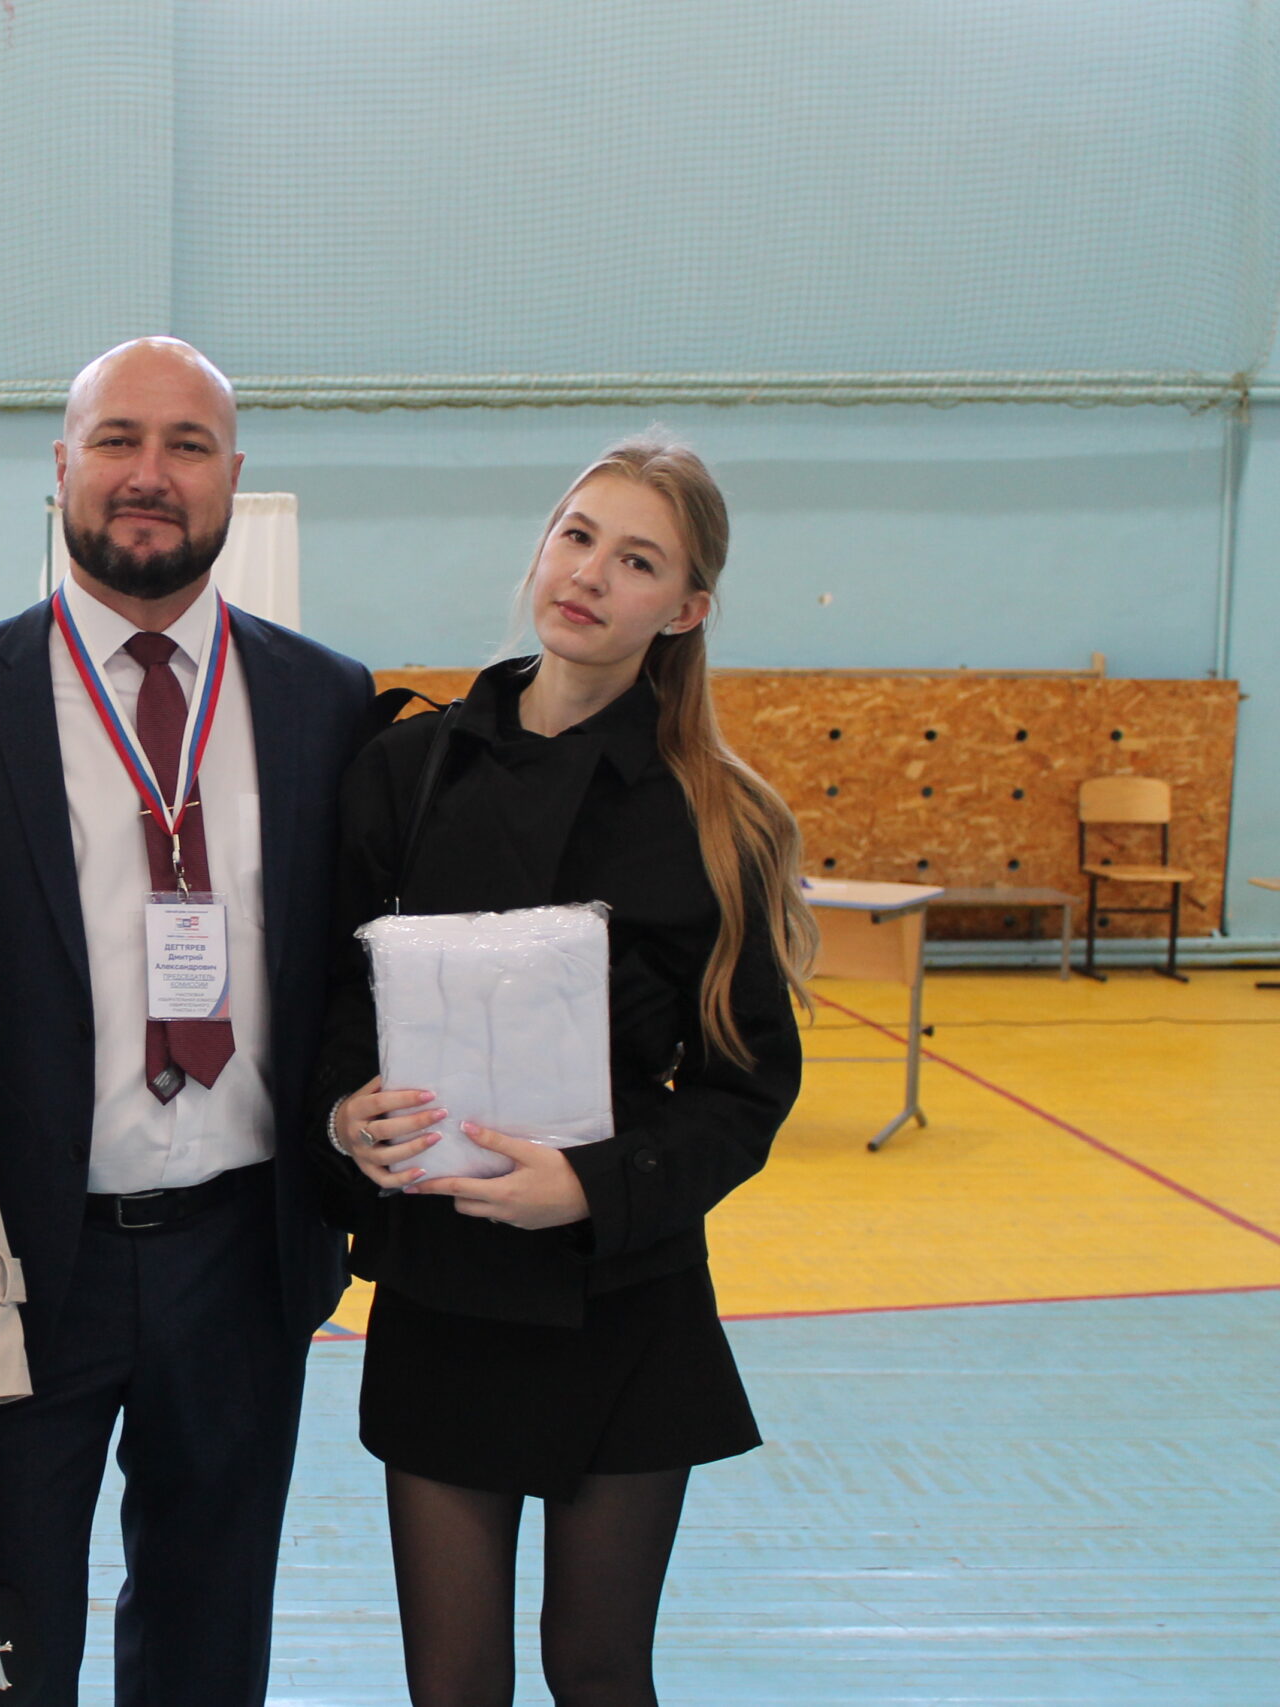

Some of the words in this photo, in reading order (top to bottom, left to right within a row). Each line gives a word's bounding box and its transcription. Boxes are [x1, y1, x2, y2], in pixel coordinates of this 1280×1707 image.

[164, 943, 206, 951] ДЕГТЯРЕВ
[168, 953, 203, 961] Дмитрий
[155, 963, 217, 971] Александрович
